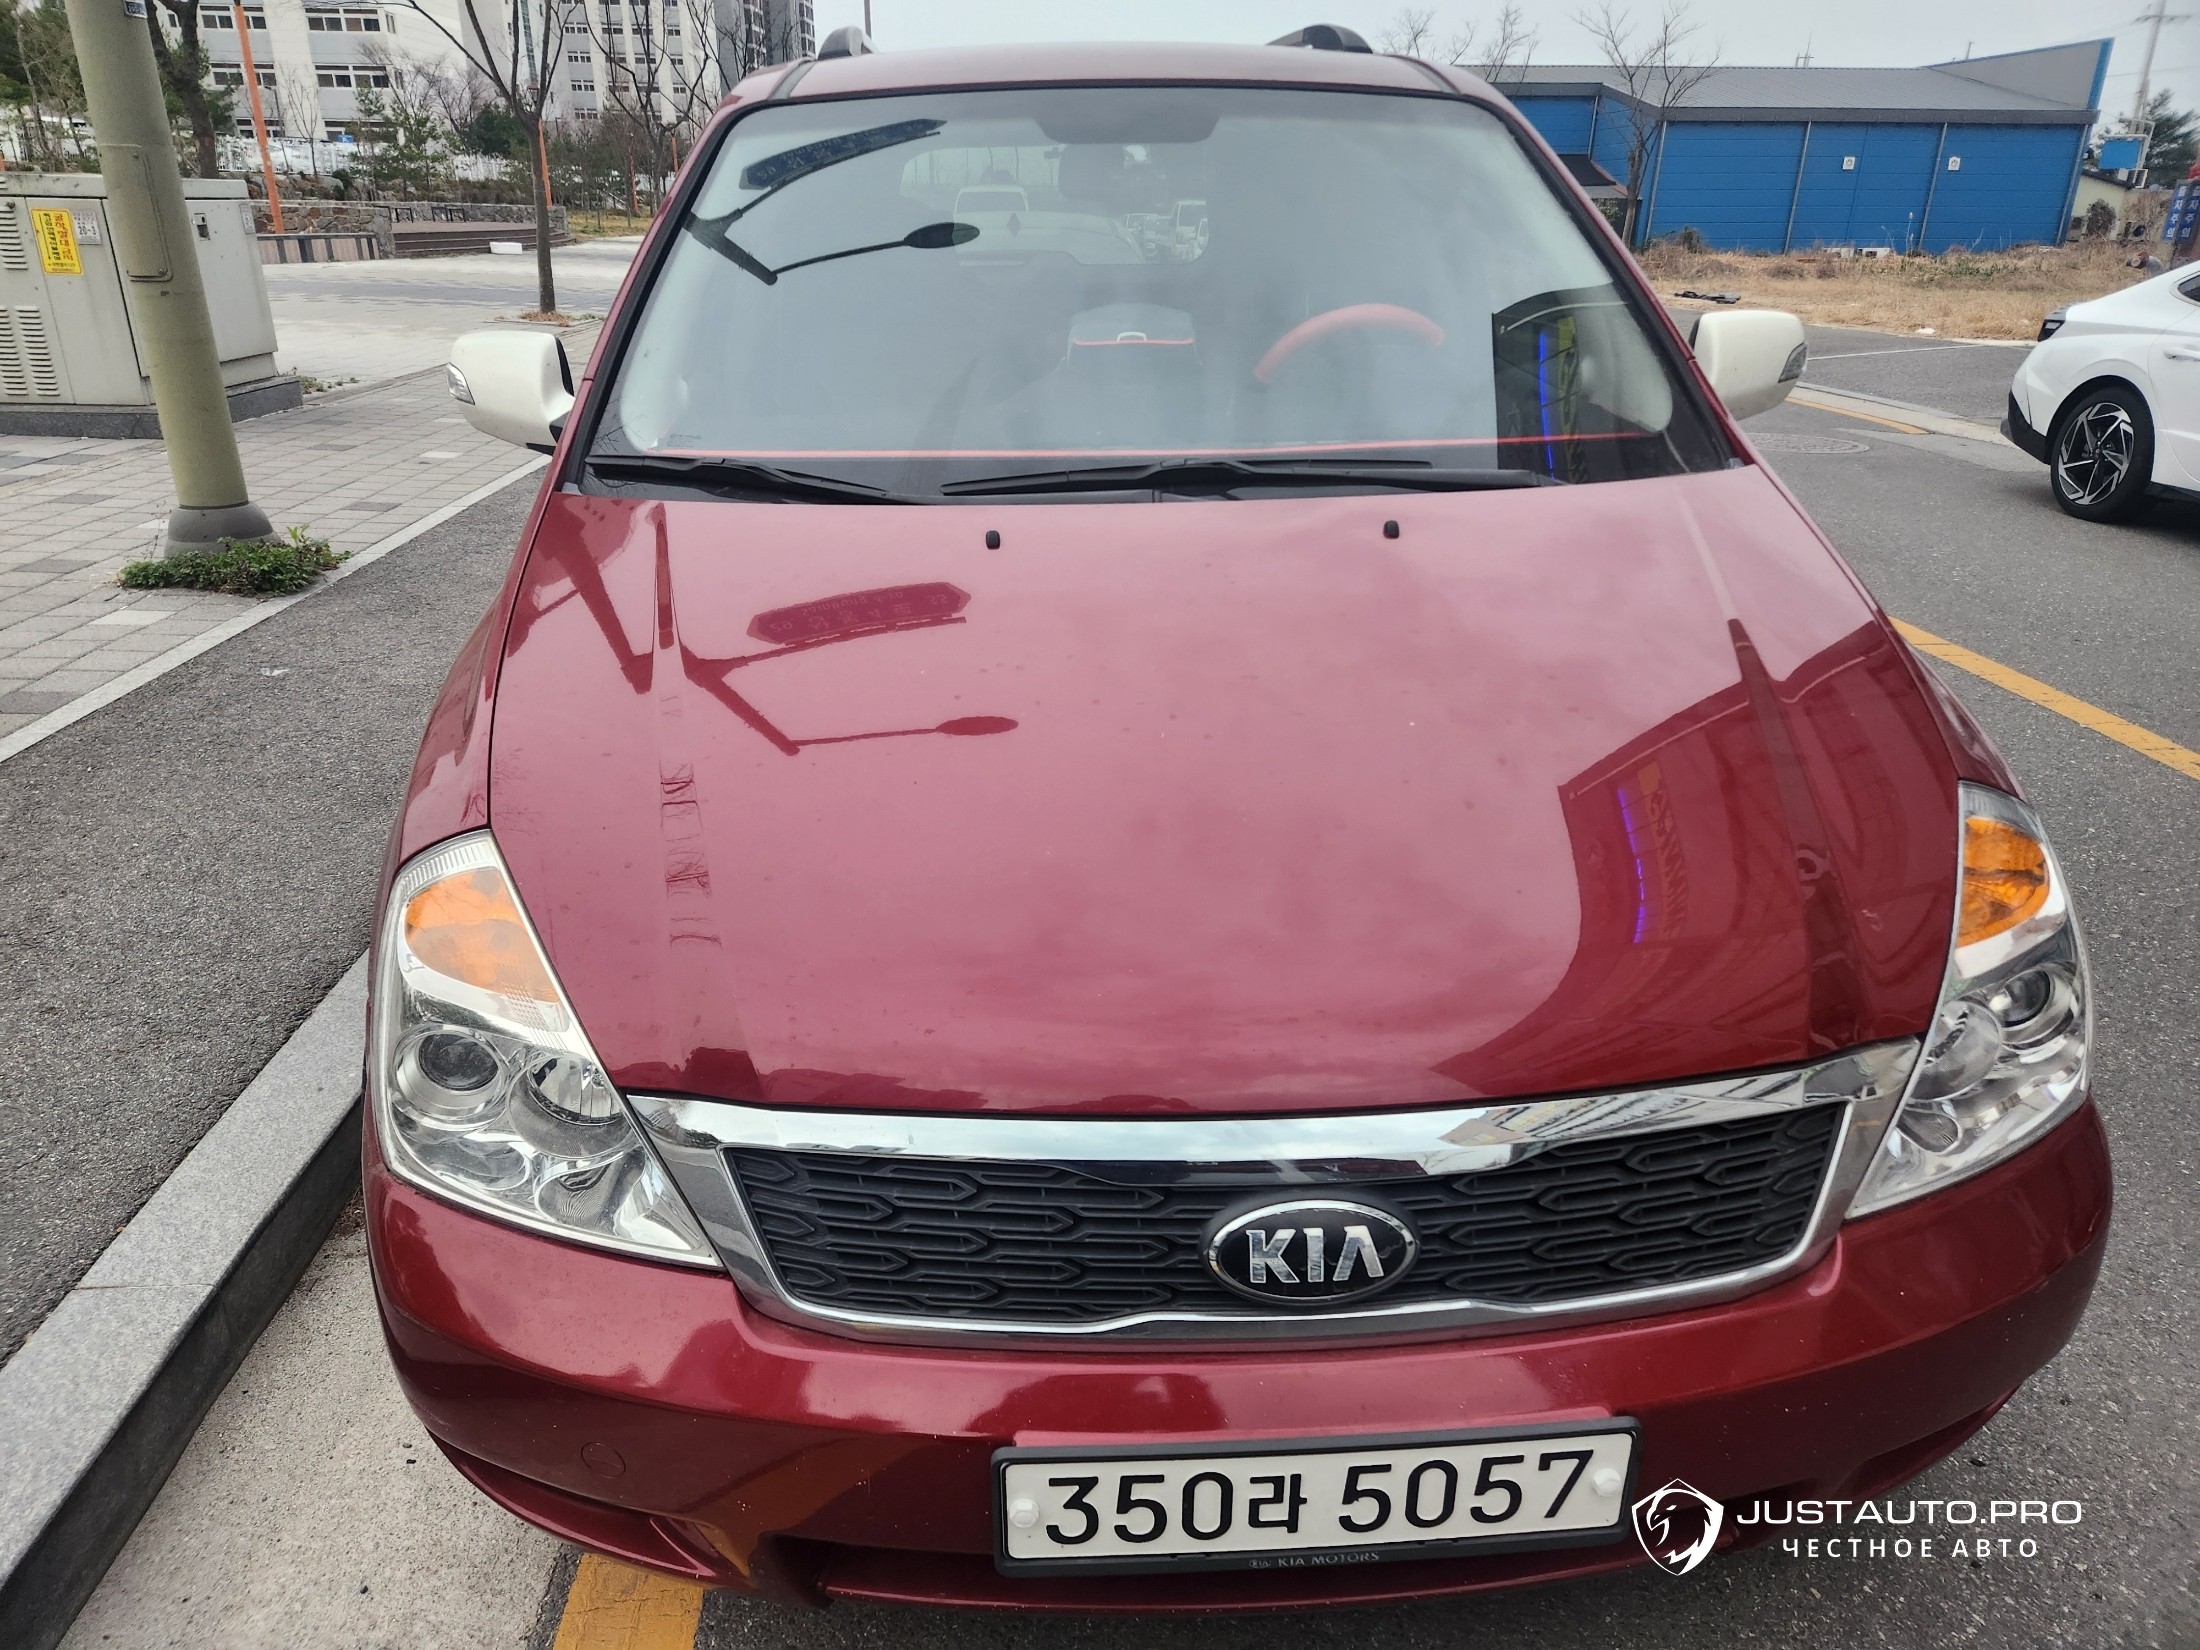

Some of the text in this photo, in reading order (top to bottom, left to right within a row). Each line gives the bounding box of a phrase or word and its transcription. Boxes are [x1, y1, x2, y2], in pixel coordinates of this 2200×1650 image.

[1246, 1225, 1384, 1284] KIA
[1045, 1449, 1595, 1545] 350라 5057
[1278, 1557, 1304, 1567] KIA
[1311, 1552, 1379, 1566] MOTORS
